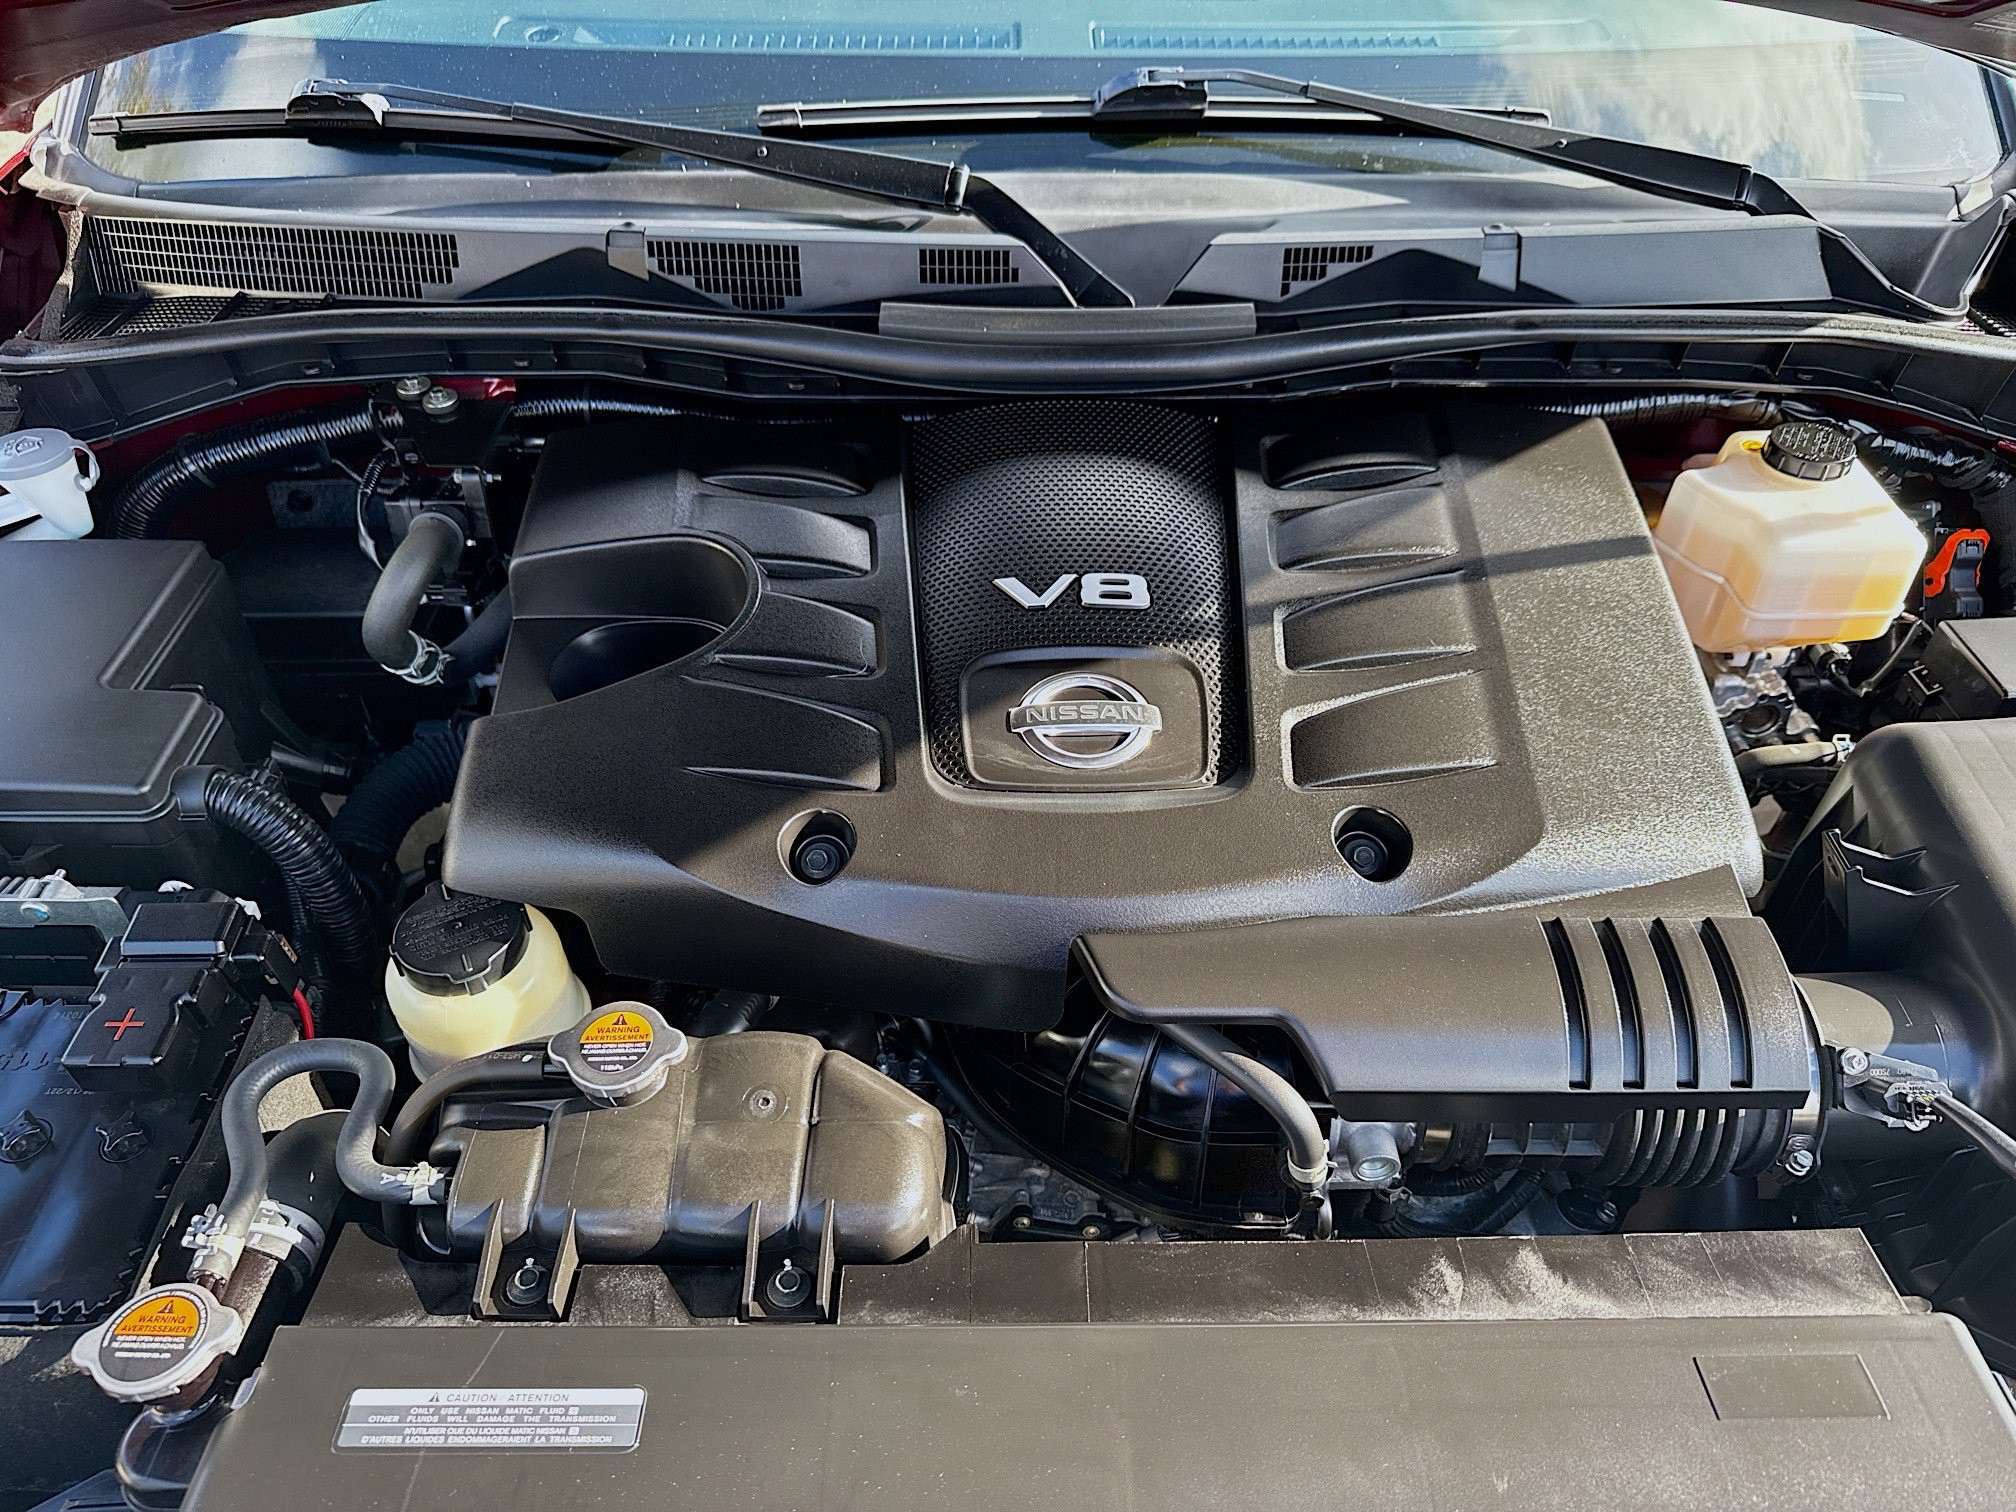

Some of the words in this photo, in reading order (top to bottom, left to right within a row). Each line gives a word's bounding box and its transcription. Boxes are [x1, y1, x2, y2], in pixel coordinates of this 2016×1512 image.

[992, 573, 1151, 610] V8
[1026, 704, 1144, 723] NISSAN
[597, 1026, 640, 1034] WARNING
[138, 1315, 187, 1324] WARNING
[121, 1325, 193, 1333] AVERTISSEMENT
[447, 1393, 498, 1402] CAUTION
[508, 1393, 570, 1402] ATTENTION
[410, 1407, 435, 1415] ONLY
[441, 1407, 460, 1415] USE
[465, 1407, 500, 1415] NISSAN
[505, 1407, 534, 1415] MATIC
[539, 1407, 566, 1415] FLUID
[368, 1415, 399, 1423] OTHER
[406, 1415, 439, 1423] FLUIDS
[447, 1415, 468, 1423] WILL
[476, 1415, 515, 1423] DAMAGE
[549, 1415, 617, 1423] TRANSMISSION
[534, 1435, 547, 1443] LA
[549, 1435, 613, 1443] TRANSMISSION
